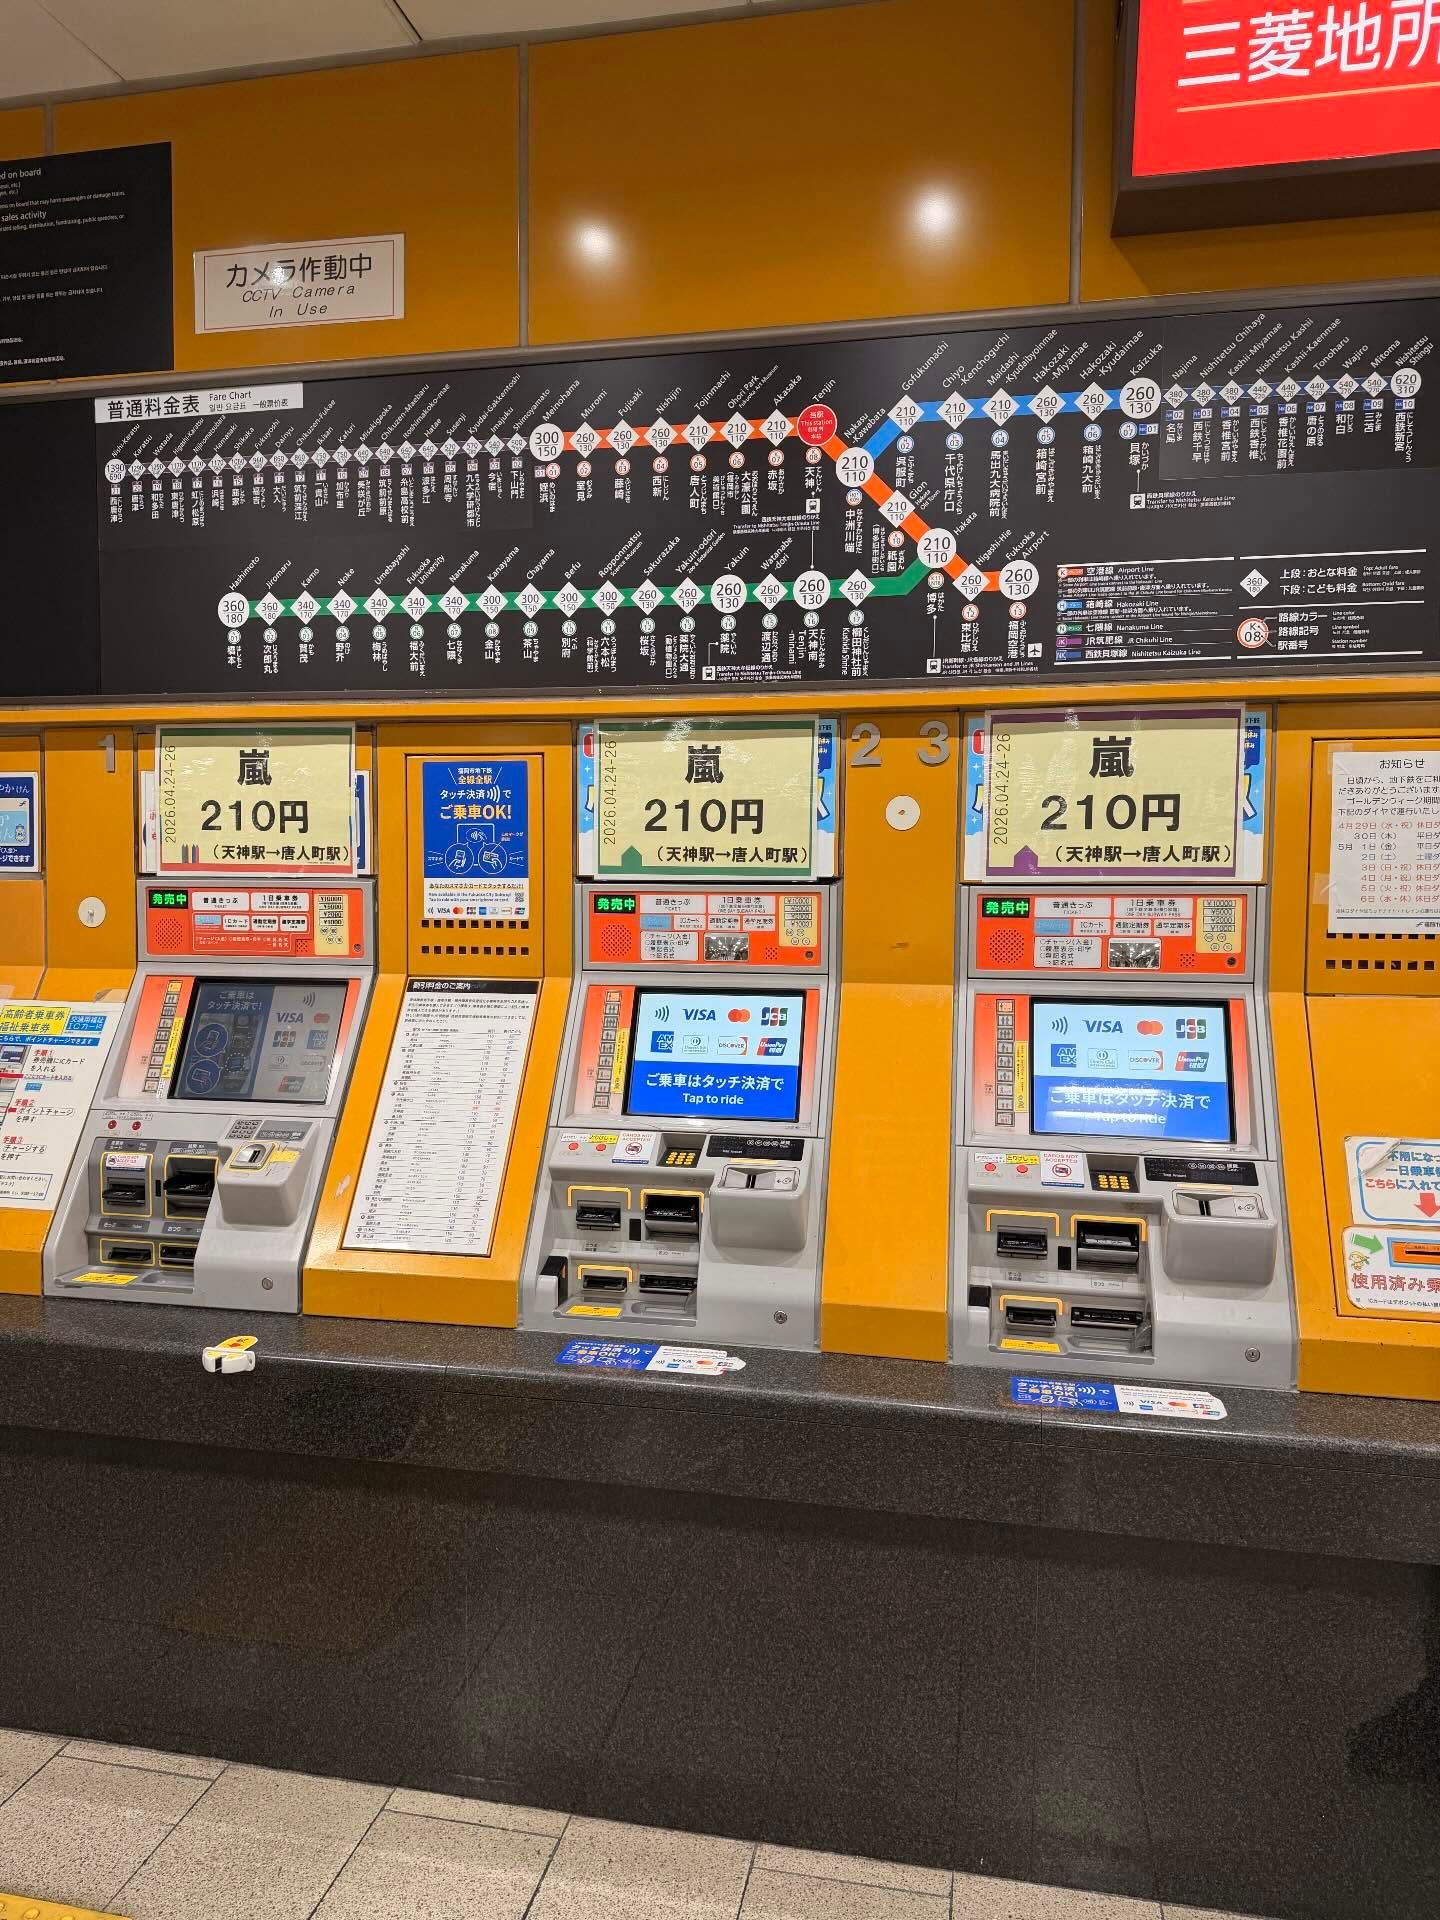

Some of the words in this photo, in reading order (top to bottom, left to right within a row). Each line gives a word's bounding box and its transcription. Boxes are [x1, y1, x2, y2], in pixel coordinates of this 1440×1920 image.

[20, 168, 41, 177] board
[2, 214, 18, 222] sales
[21, 211, 46, 220] activity
[226, 253, 372, 288] カメラ作動中
[242, 287, 282, 303] CCTV
[292, 283, 356, 299] Camera
[269, 306, 283, 318] In
[297, 302, 327, 317] Use
[1234, 312, 1267, 345] Chihaya
[1032, 344, 1070, 383] Hakozaki
[1079, 341, 1118, 380] Hakozaki
[1129, 343, 1163, 376] Kaizuka
[1313, 335, 1350, 371] Tonoharu
[1342, 344, 1370, 369] Wajiro
[1370, 339, 1401, 369] Mitoma
[1395, 334, 1429, 367] Nishitetsu
[1409, 342, 1434, 366] Shingu
[902, 341, 949, 391] Gofukumachi
[942, 365, 965, 388] Chiyo
[987, 352, 1020, 386] Maidashi
[1172, 355, 1198, 381] Najima
[694, 370, 732, 411] Tojinmachi
[727, 389, 747, 409] Ohori
[744, 375, 760, 392] Park
[773, 375, 802, 406] Akasaka
[812, 378, 837, 402] Tenjin
[1395, 374, 1417, 385] 620
[209, 393, 226, 401] Fare
[229, 391, 251, 400] Chart
[542, 380, 580, 422] Meinohama
[581, 389, 608, 419] Muromi
[618, 388, 644, 417] Fujisaki
[655, 386, 682, 415] Nishijin
[1127, 387, 1155, 399] 260
[108, 395, 199, 419] 普通料金表
[946, 403, 965, 413] 210
[1129, 402, 1152, 413] 130
[535, 432, 559, 445] 300
[576, 433, 594, 443] 260
[689, 426, 708, 436] 210
[767, 421, 786, 430] 210
[844, 412, 869, 439] Nakasu
[538, 446, 557, 456] 150
[842, 456, 868, 469] 210
[805, 467, 815, 488] 天神
[845, 472, 866, 482] 110
[954, 511, 978, 536] Hakata
[598, 530, 642, 578] Ropponmatsu
[644, 536, 680, 576] Sakurazaka
[675, 529, 717, 574] Yakuin-odori
[761, 537, 794, 570] Watanabe
[924, 537, 950, 550] 210
[975, 529, 1013, 566] Higashi-Hie
[1006, 530, 1036, 560] Fukuoka
[1022, 531, 1050, 559] Airport
[374, 545, 410, 586] Umebayashi
[406, 558, 431, 585] Fukuoka
[417, 554, 446, 585] University
[449, 549, 480, 583] Nanakuma
[486, 546, 520, 582] Kanayama
[526, 548, 556, 581] Chayama
[564, 561, 581, 579] Befu
[724, 546, 750, 571] Yakuin
[229, 556, 260, 591] Hashimoto
[266, 560, 292, 590] Jiromaru
[301, 568, 320, 588] Kamo
[337, 568, 356, 587] Noke
[800, 579, 825, 592] 260
[1004, 569, 1033, 582] 260
[716, 583, 742, 596] 260
[1008, 584, 1030, 595] 130
[223, 601, 245, 611] 360
[98, 734, 115, 773] 1
[851, 723, 882, 768] 2
[918, 721, 950, 767] 3
[1088, 735, 1134, 778] 嵐
[237, 749, 272, 786] 嵐
[684, 744, 724, 784] 嵐
[1380, 759, 1425, 769] お知らせ
[458, 775, 492, 784] 全線全駅
[603, 739, 617, 845] 2026.04.24-26
[993, 732, 1012, 846] 2026.04.24-26
[164, 745, 176, 844] 2026.04.24-26
[440, 789, 485, 800] タッチ決済
[201, 800, 309, 834] 210円
[644, 798, 764, 835] 210円
[1040, 793, 1181, 832] 210円
[152, 893, 187, 905] 発売中
[597, 898, 636, 912] 発売中
[986, 902, 1029, 916] 発売中
[276, 1012, 304, 1023] VISA
[682, 1009, 716, 1021] VISA
[760, 1007, 789, 1026] JCB
[1082, 1019, 1123, 1034] VISA
[1175, 1018, 1207, 1040] JCB
[646, 1073, 784, 1091] ご乗車はタッチ決済で
[683, 1093, 704, 1105] Tap
[706, 1094, 718, 1104] to
[721, 1094, 744, 1105] ride
